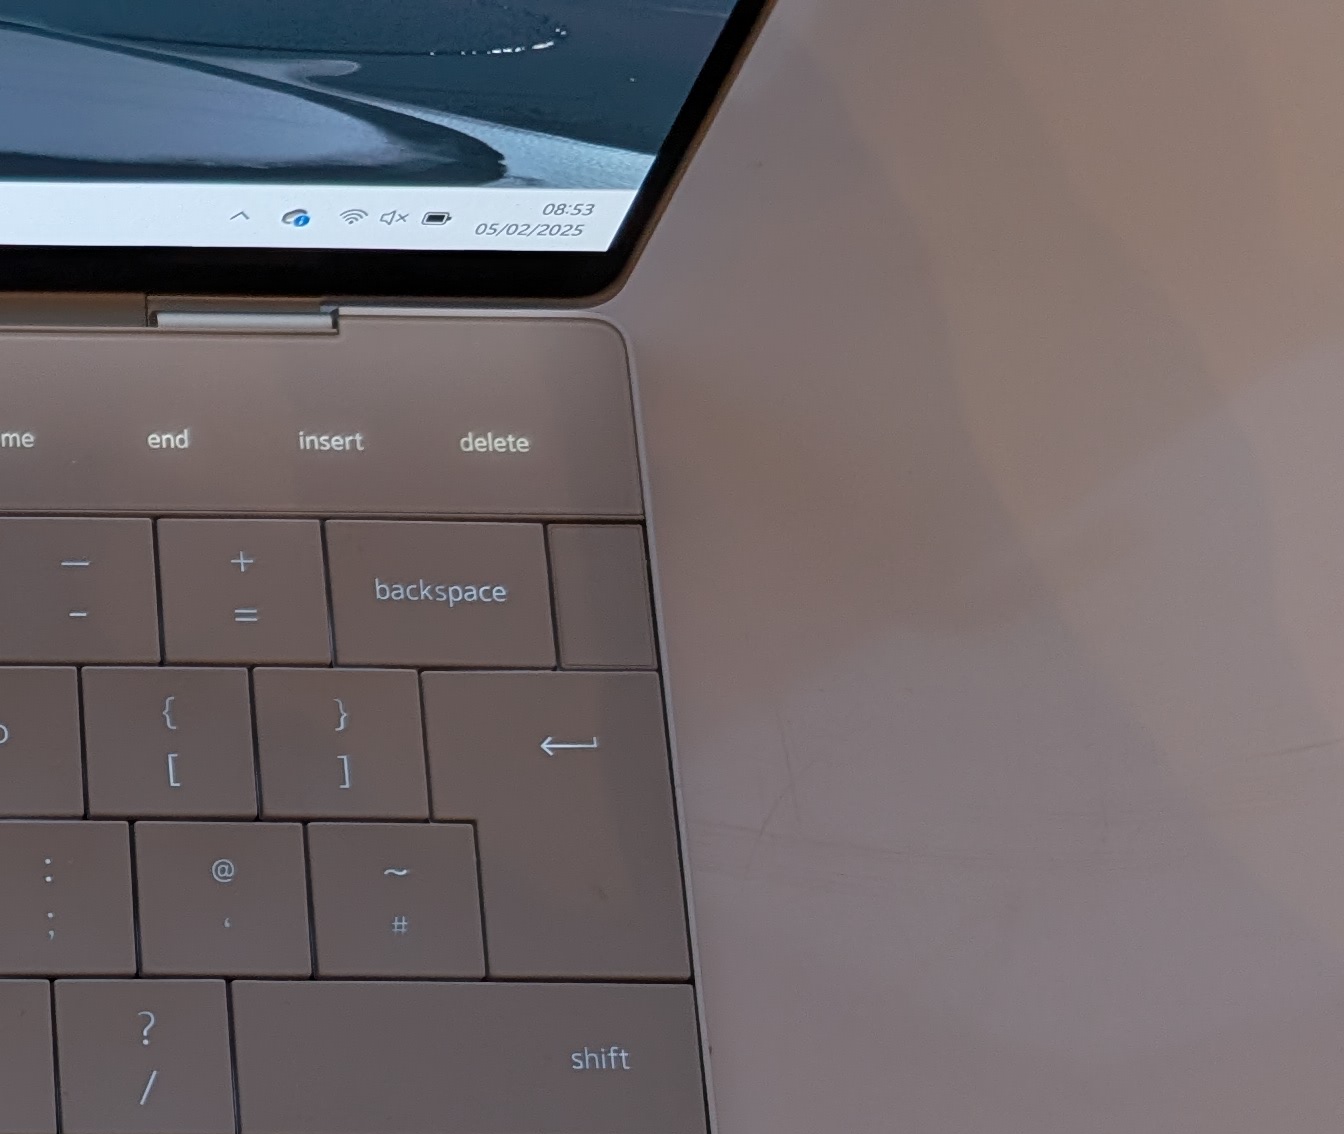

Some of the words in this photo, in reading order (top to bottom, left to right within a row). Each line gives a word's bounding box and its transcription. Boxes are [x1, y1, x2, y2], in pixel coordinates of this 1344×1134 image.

[542, 203, 596, 217] 08:53
[474, 222, 585, 237] 05/02/2025
[147, 428, 189, 449] end
[298, 430, 365, 451] insert
[460, 431, 530, 453] delete
[374, 577, 507, 608] backspace
[211, 858, 235, 883] @
[391, 915, 408, 933] #
[138, 1011, 155, 1046] ?
[571, 1046, 631, 1070] shift
